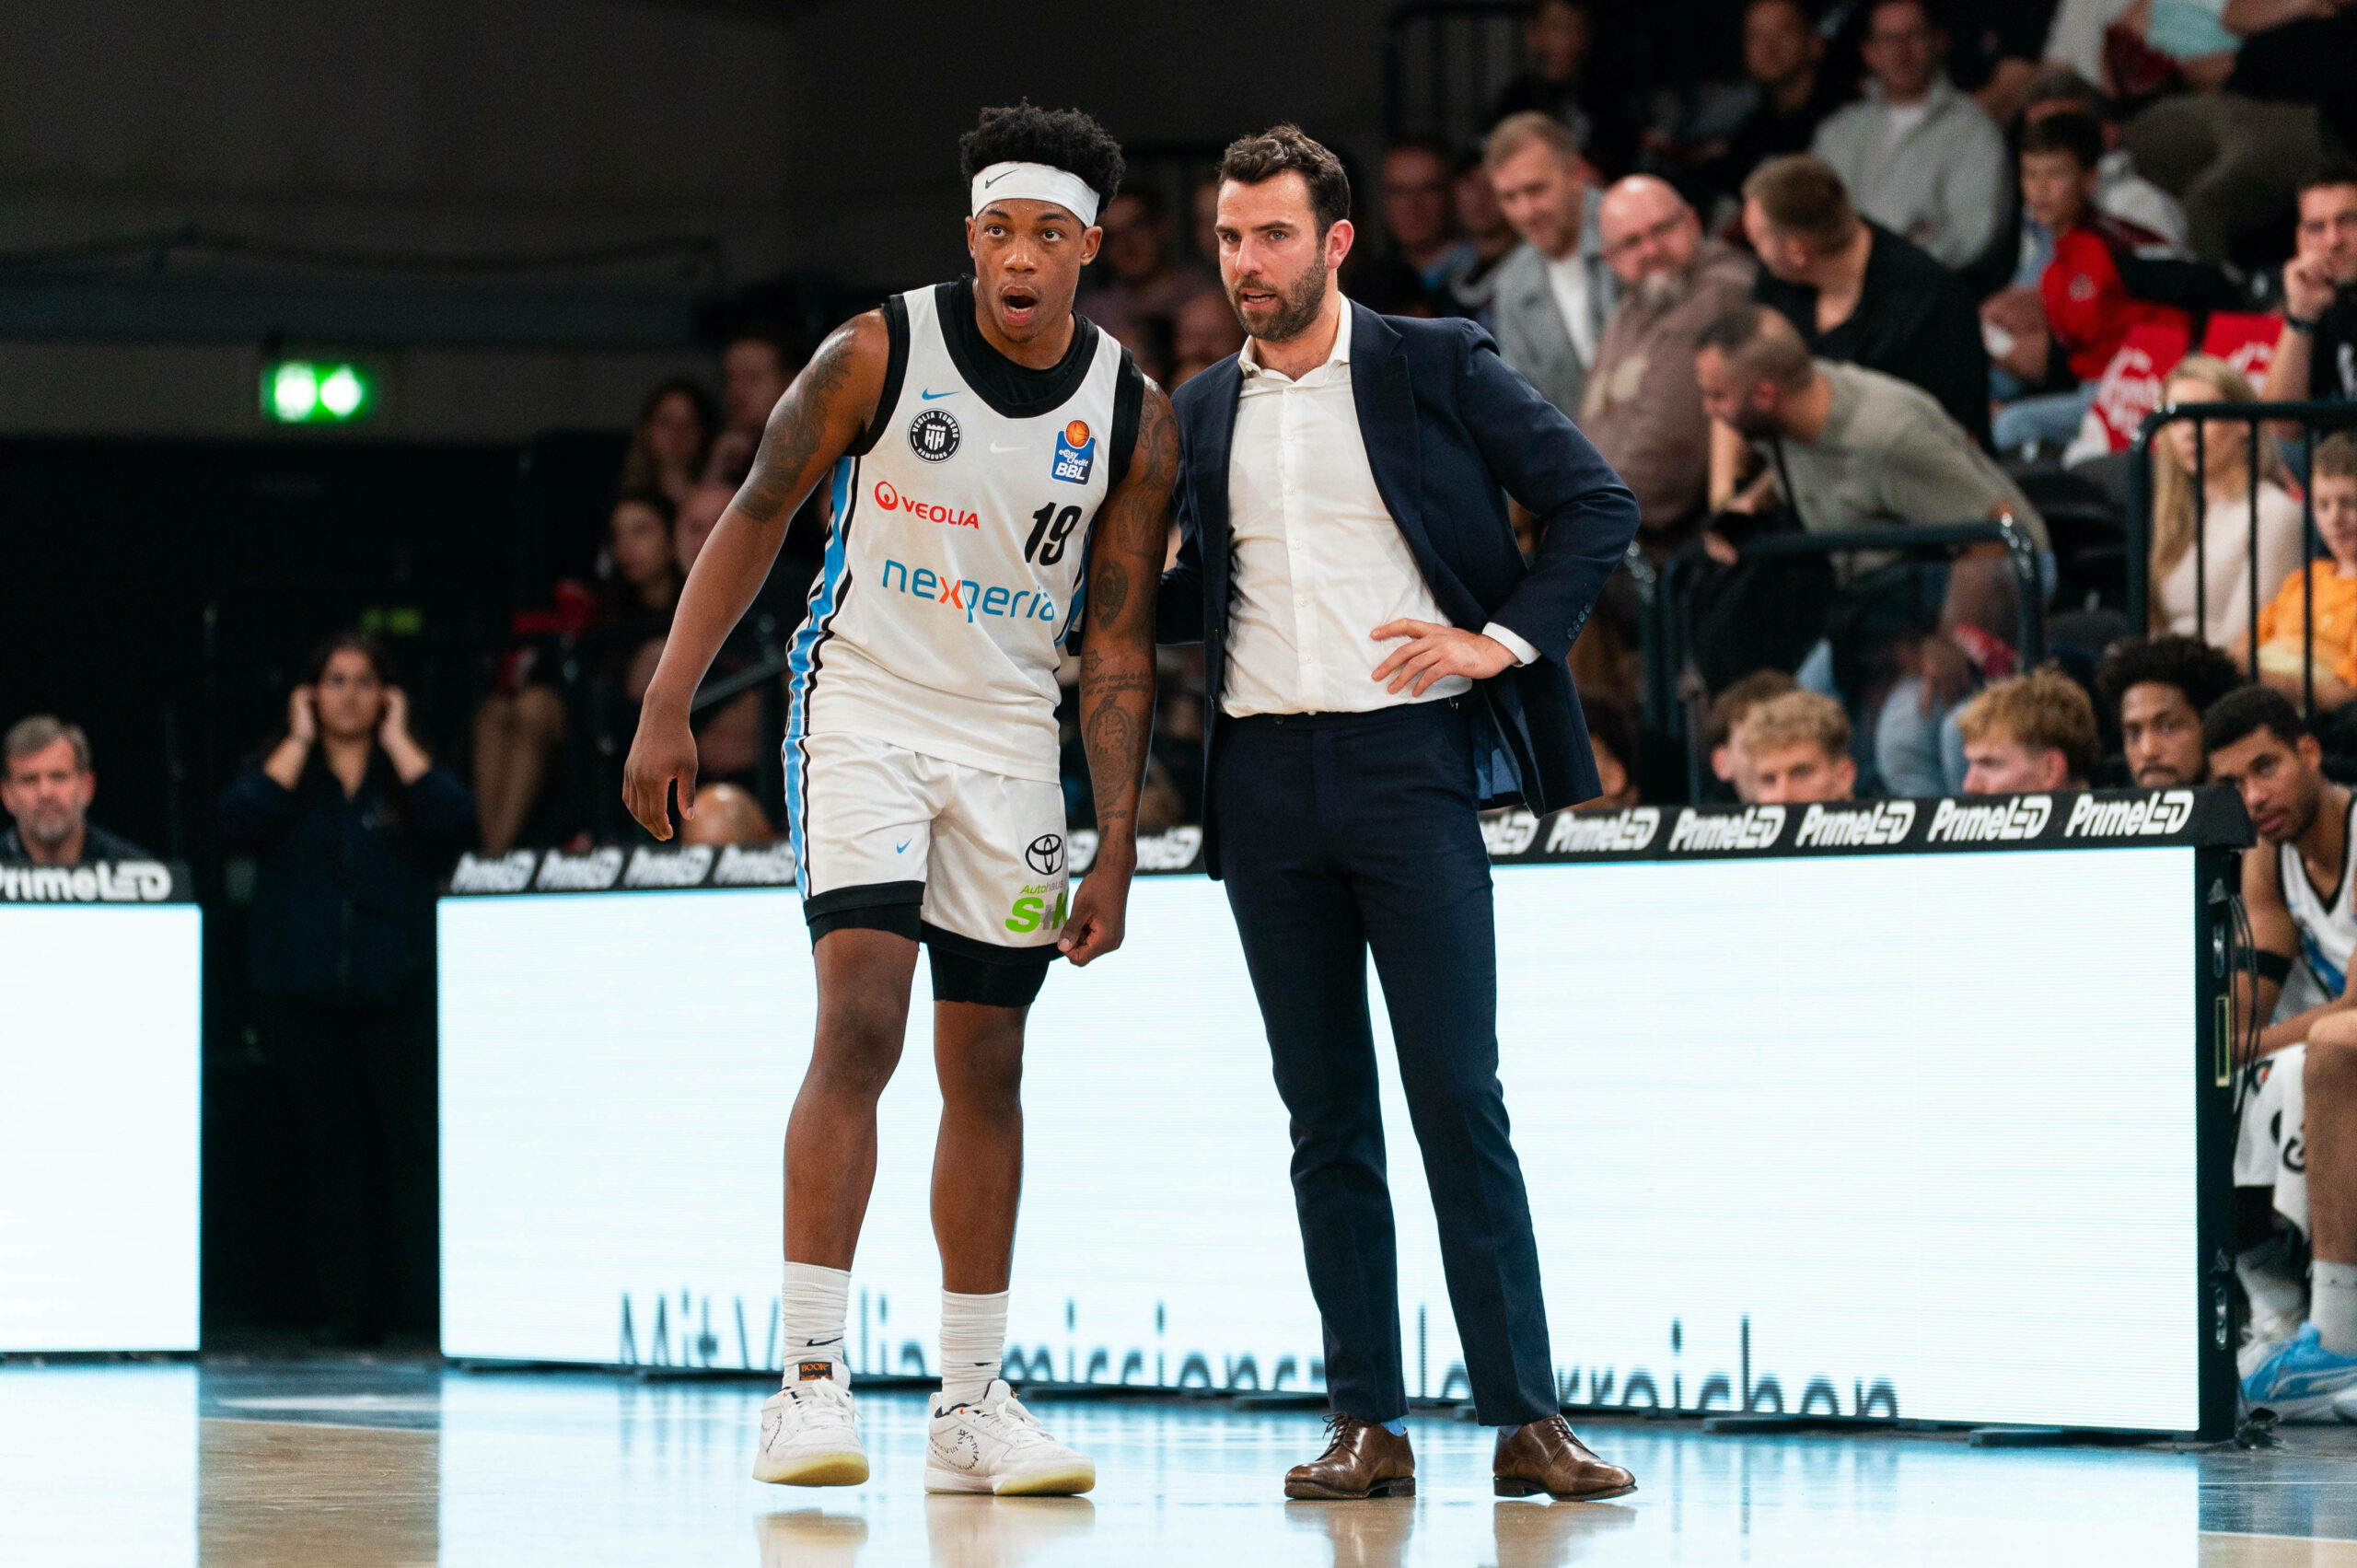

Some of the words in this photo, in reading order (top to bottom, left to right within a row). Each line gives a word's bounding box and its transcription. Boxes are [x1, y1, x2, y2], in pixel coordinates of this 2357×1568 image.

[911, 412, 935, 433] VEOLIA
[938, 412, 959, 439] TOWERS
[917, 447, 948, 460] HAMBURG
[1054, 461, 1086, 481] BBL
[901, 496, 980, 529] VEOLIA
[1024, 501, 1083, 566] 19
[1544, 807, 1660, 854] PrimeLED
[1667, 805, 1786, 852] PrimeLED
[1794, 800, 1916, 847] PrimeLED
[1926, 795, 2053, 842] PrimeLED
[2064, 790, 2195, 838] PrimeLED
[0, 860, 173, 901] rimeLED
[801, 1363, 829, 1372] BOOK
